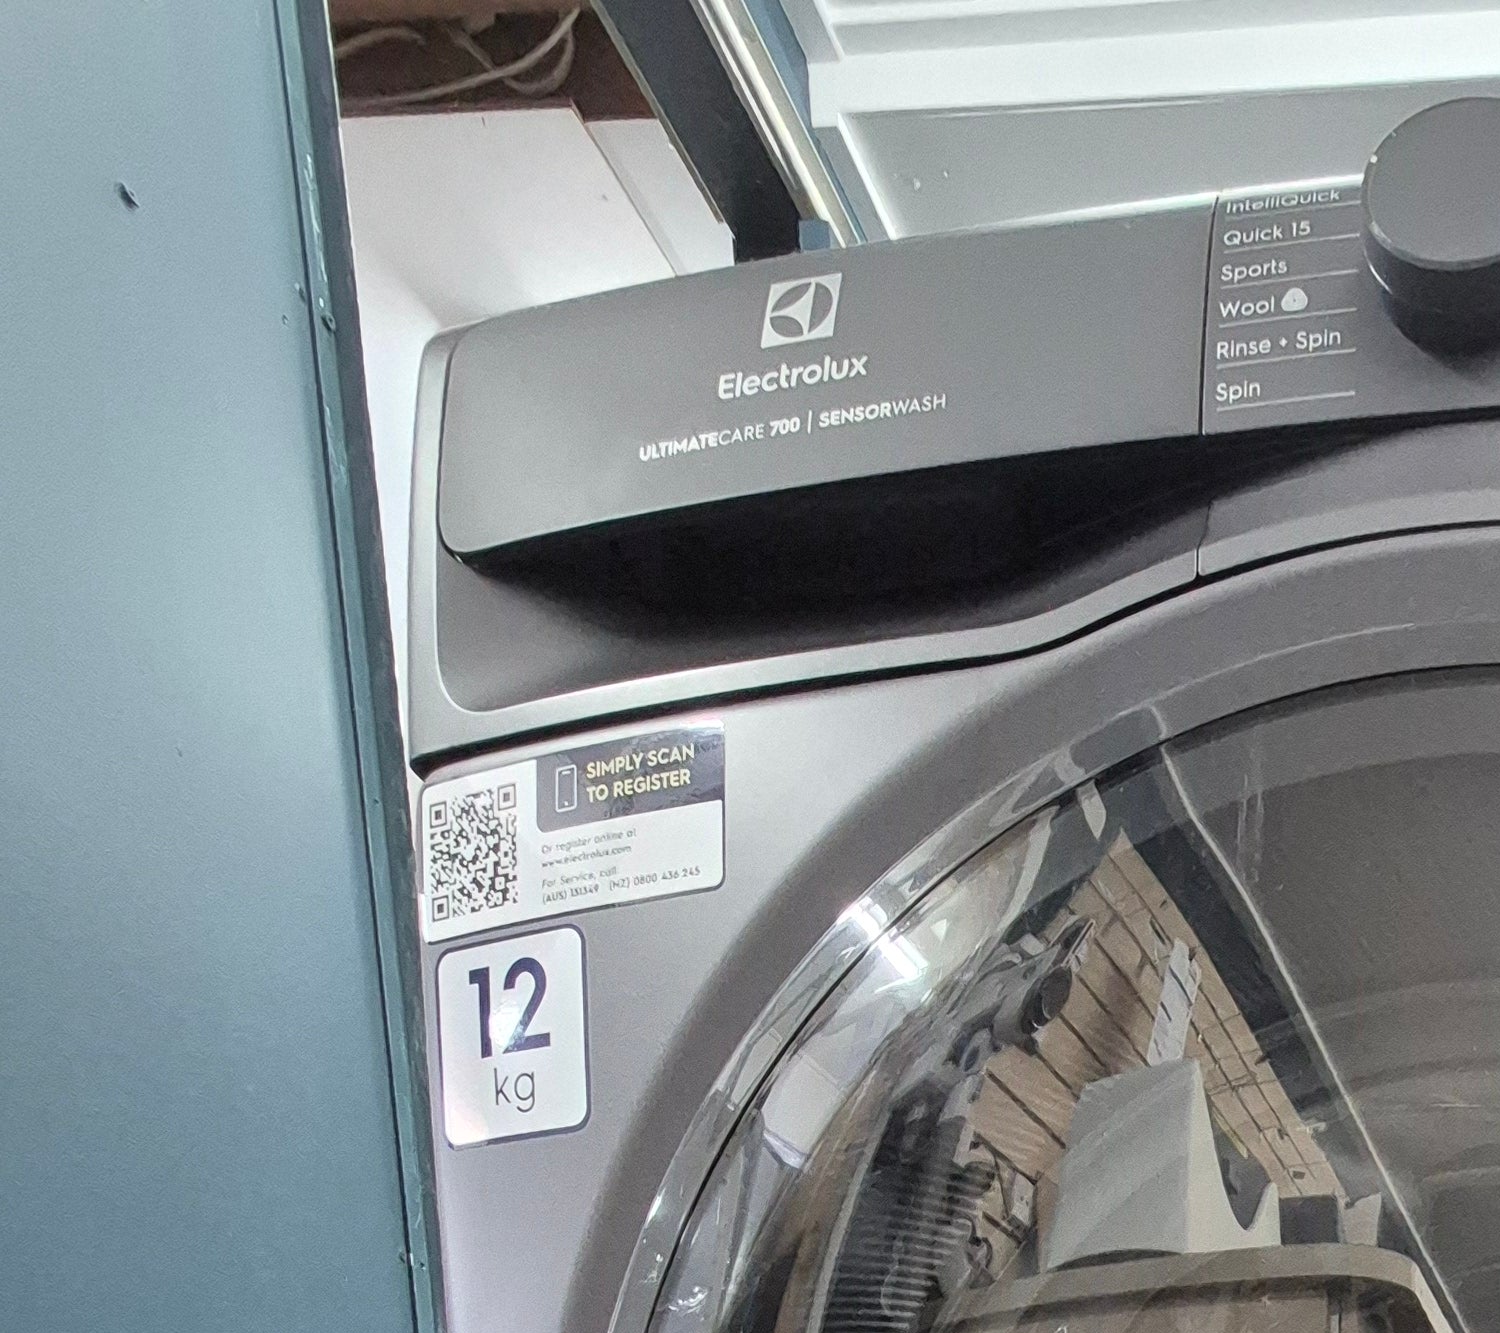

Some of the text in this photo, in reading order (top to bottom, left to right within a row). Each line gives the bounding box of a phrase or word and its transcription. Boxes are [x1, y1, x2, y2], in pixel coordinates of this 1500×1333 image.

[1226, 190, 1340, 213] IntelliQuick
[1223, 220, 1311, 246] Quick 15
[1221, 259, 1287, 282] Sports
[1219, 296, 1275, 318] Wool
[1216, 338, 1271, 360] Rinse
[1296, 329, 1341, 352] Spin
[718, 355, 868, 399] Electrolux
[1215, 380, 1261, 404] Spin
[639, 393, 947, 461] ULTIMATECARE 700 SENSORWASH
[586, 743, 695, 780] SIMPLY SCAN
[586, 769, 691, 804] TO REGISTER
[555, 836, 591, 852] register
[542, 878, 556, 889] For
[542, 889, 567, 905] (AUS)
[609, 877, 630, 891] (NZ)
[469, 956, 551, 1059] 12
[494, 1067, 535, 1113] kg
